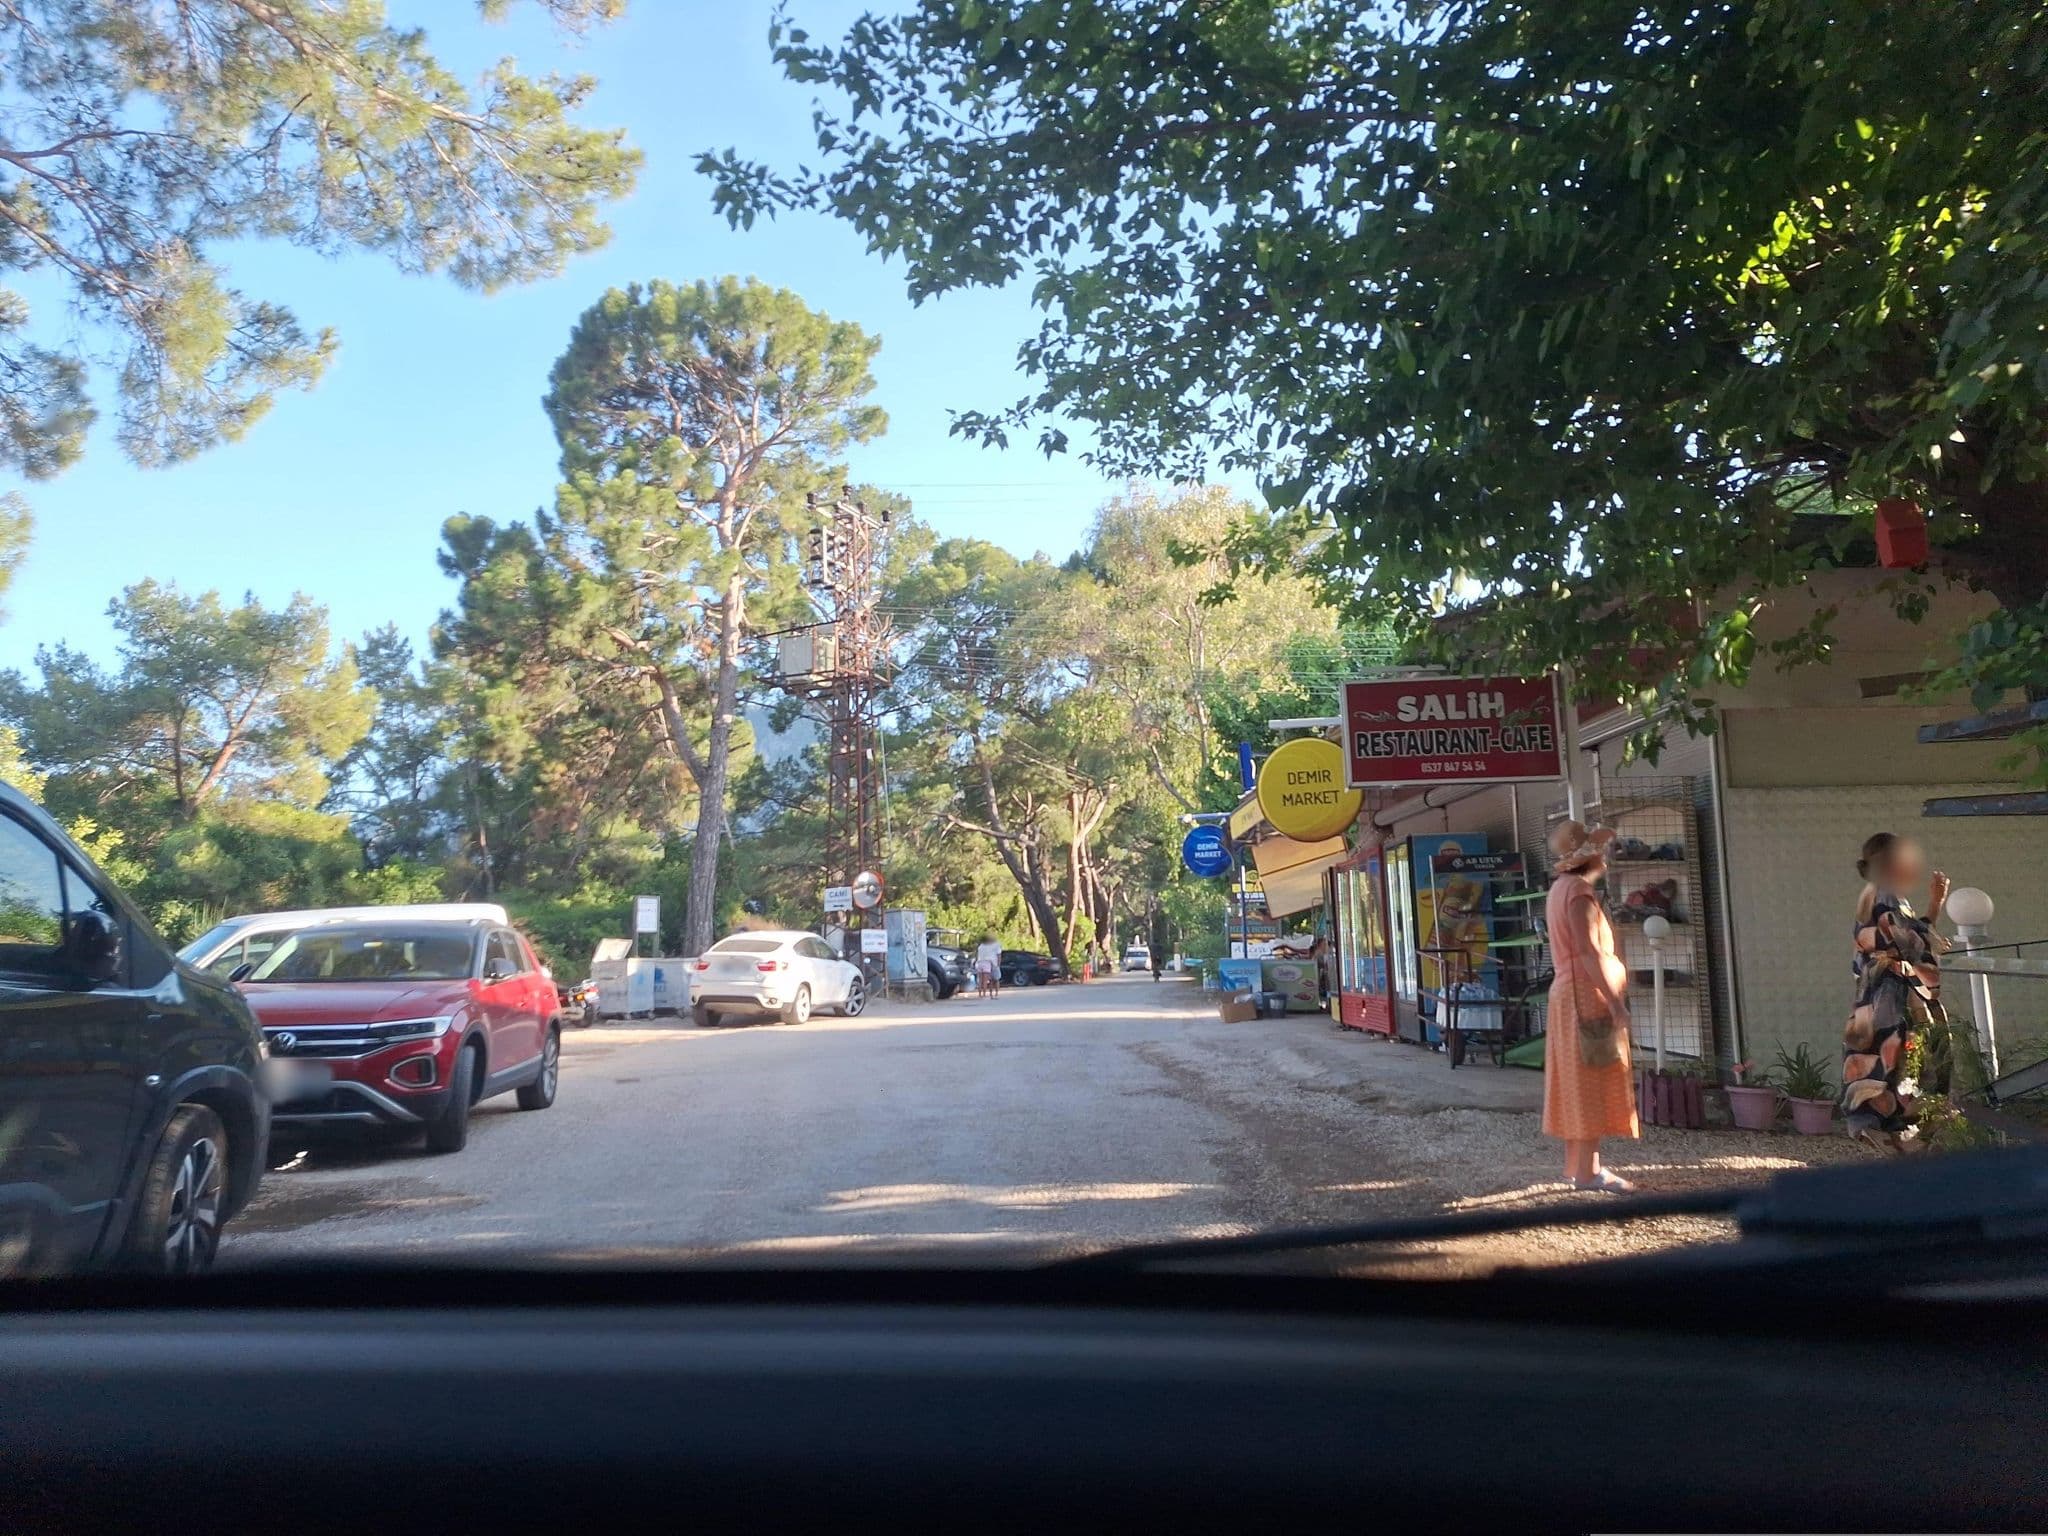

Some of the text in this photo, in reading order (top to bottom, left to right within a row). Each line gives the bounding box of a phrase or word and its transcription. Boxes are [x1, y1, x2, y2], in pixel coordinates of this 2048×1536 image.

[1356, 726, 1552, 758] RESTAURANT-CAFE
[1420, 762, 1442, 773] 0537
[1461, 761, 1473, 771] 54
[1475, 761, 1487, 771] 54
[1282, 789, 1340, 807] MARKET
